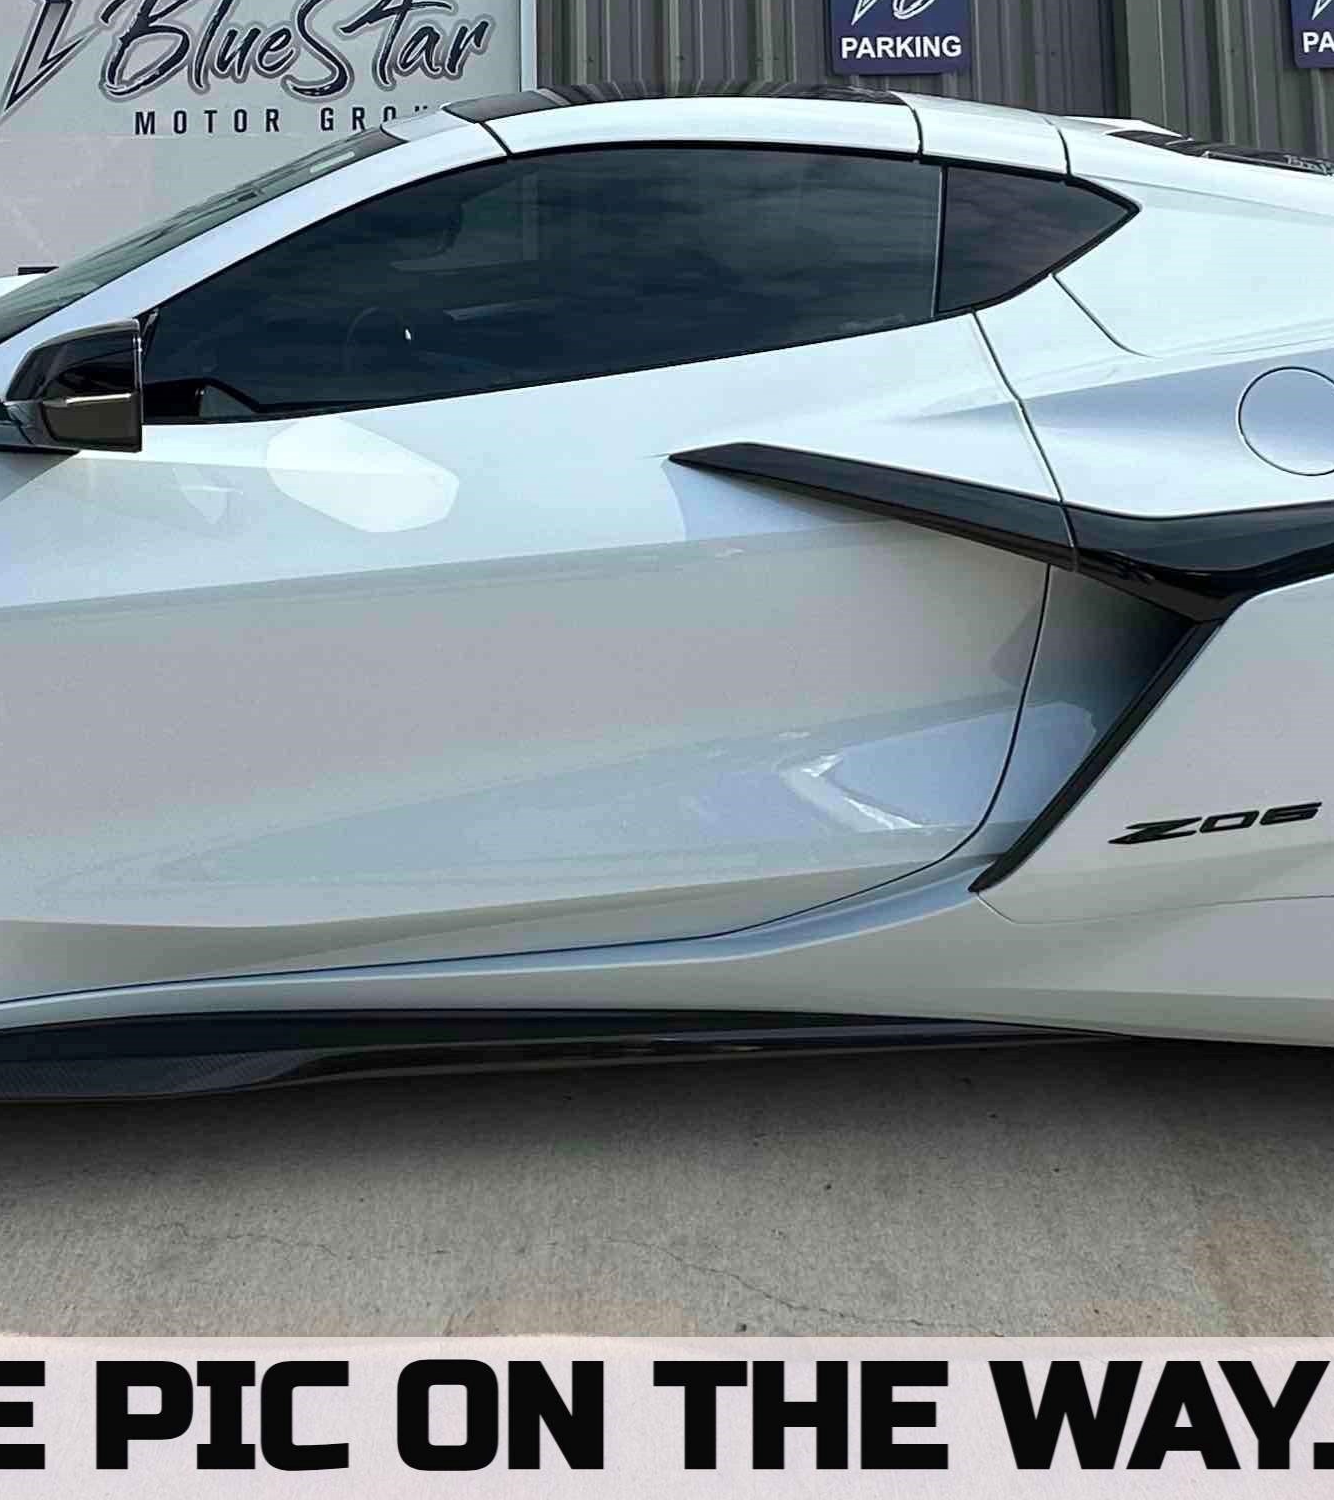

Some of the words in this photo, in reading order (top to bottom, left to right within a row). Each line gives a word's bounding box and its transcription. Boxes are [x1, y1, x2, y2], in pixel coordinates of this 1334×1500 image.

[840, 35, 963, 60] PARKING
[133, 108, 280, 136] MOTOR
[319, 104, 429, 133] GRO
[1107, 801, 1323, 845] Z06
